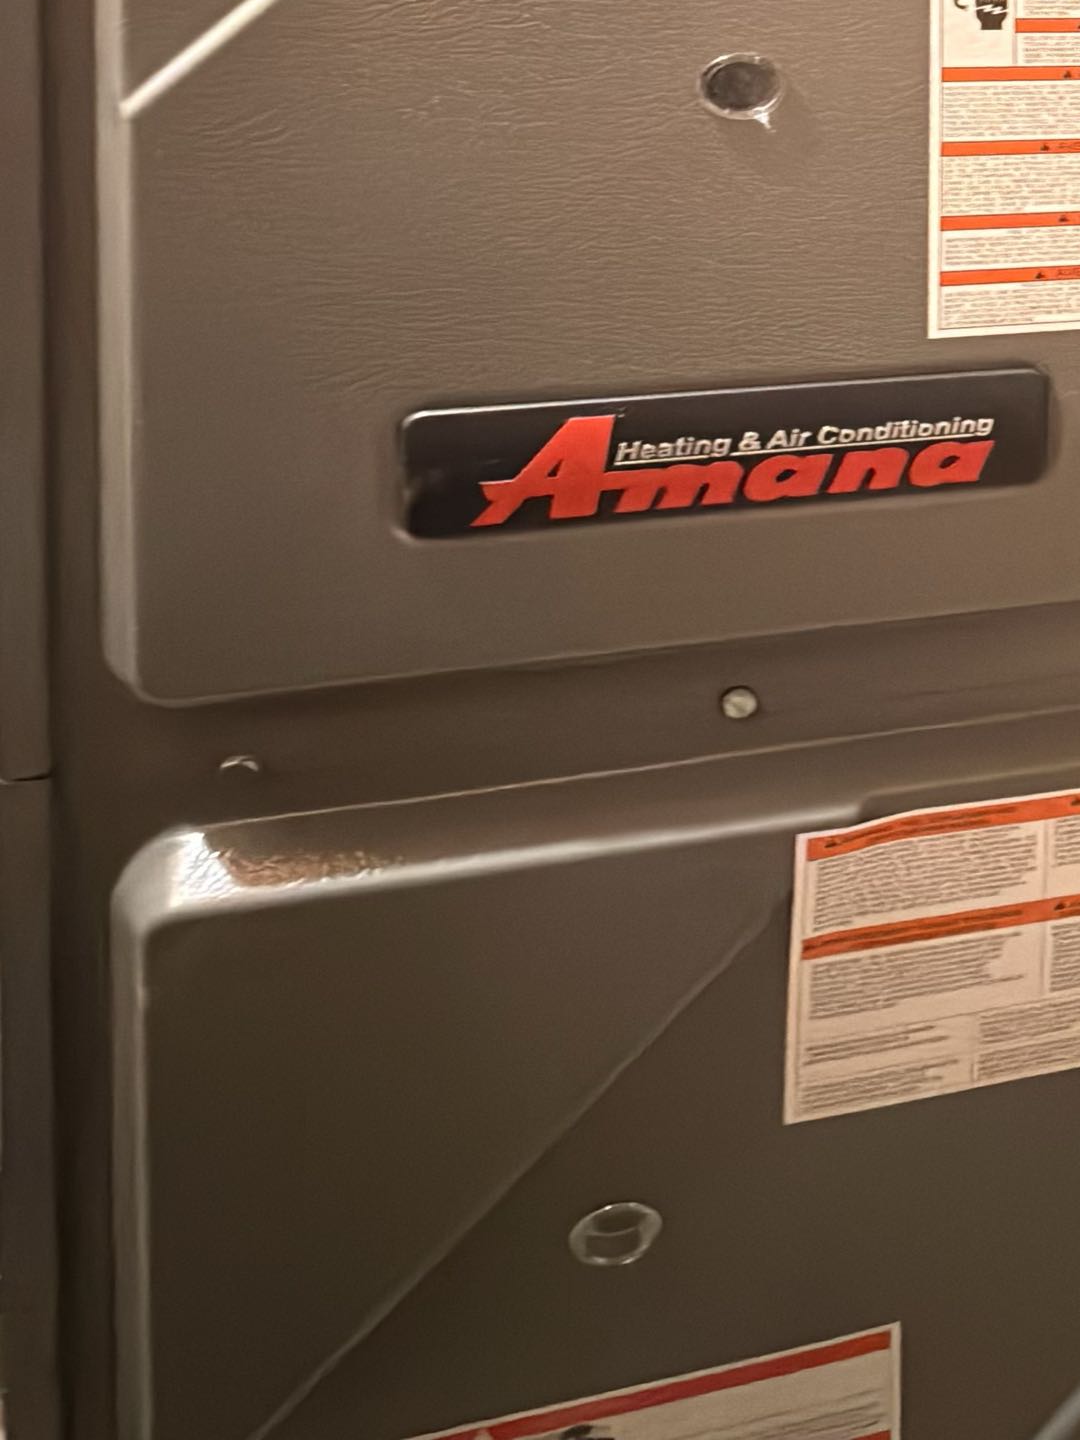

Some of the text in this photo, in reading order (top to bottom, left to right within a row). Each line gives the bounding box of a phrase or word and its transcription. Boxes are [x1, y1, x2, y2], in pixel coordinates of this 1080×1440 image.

[470, 414, 996, 528] Amana
[615, 417, 995, 462] Heating & Air Conditioning
